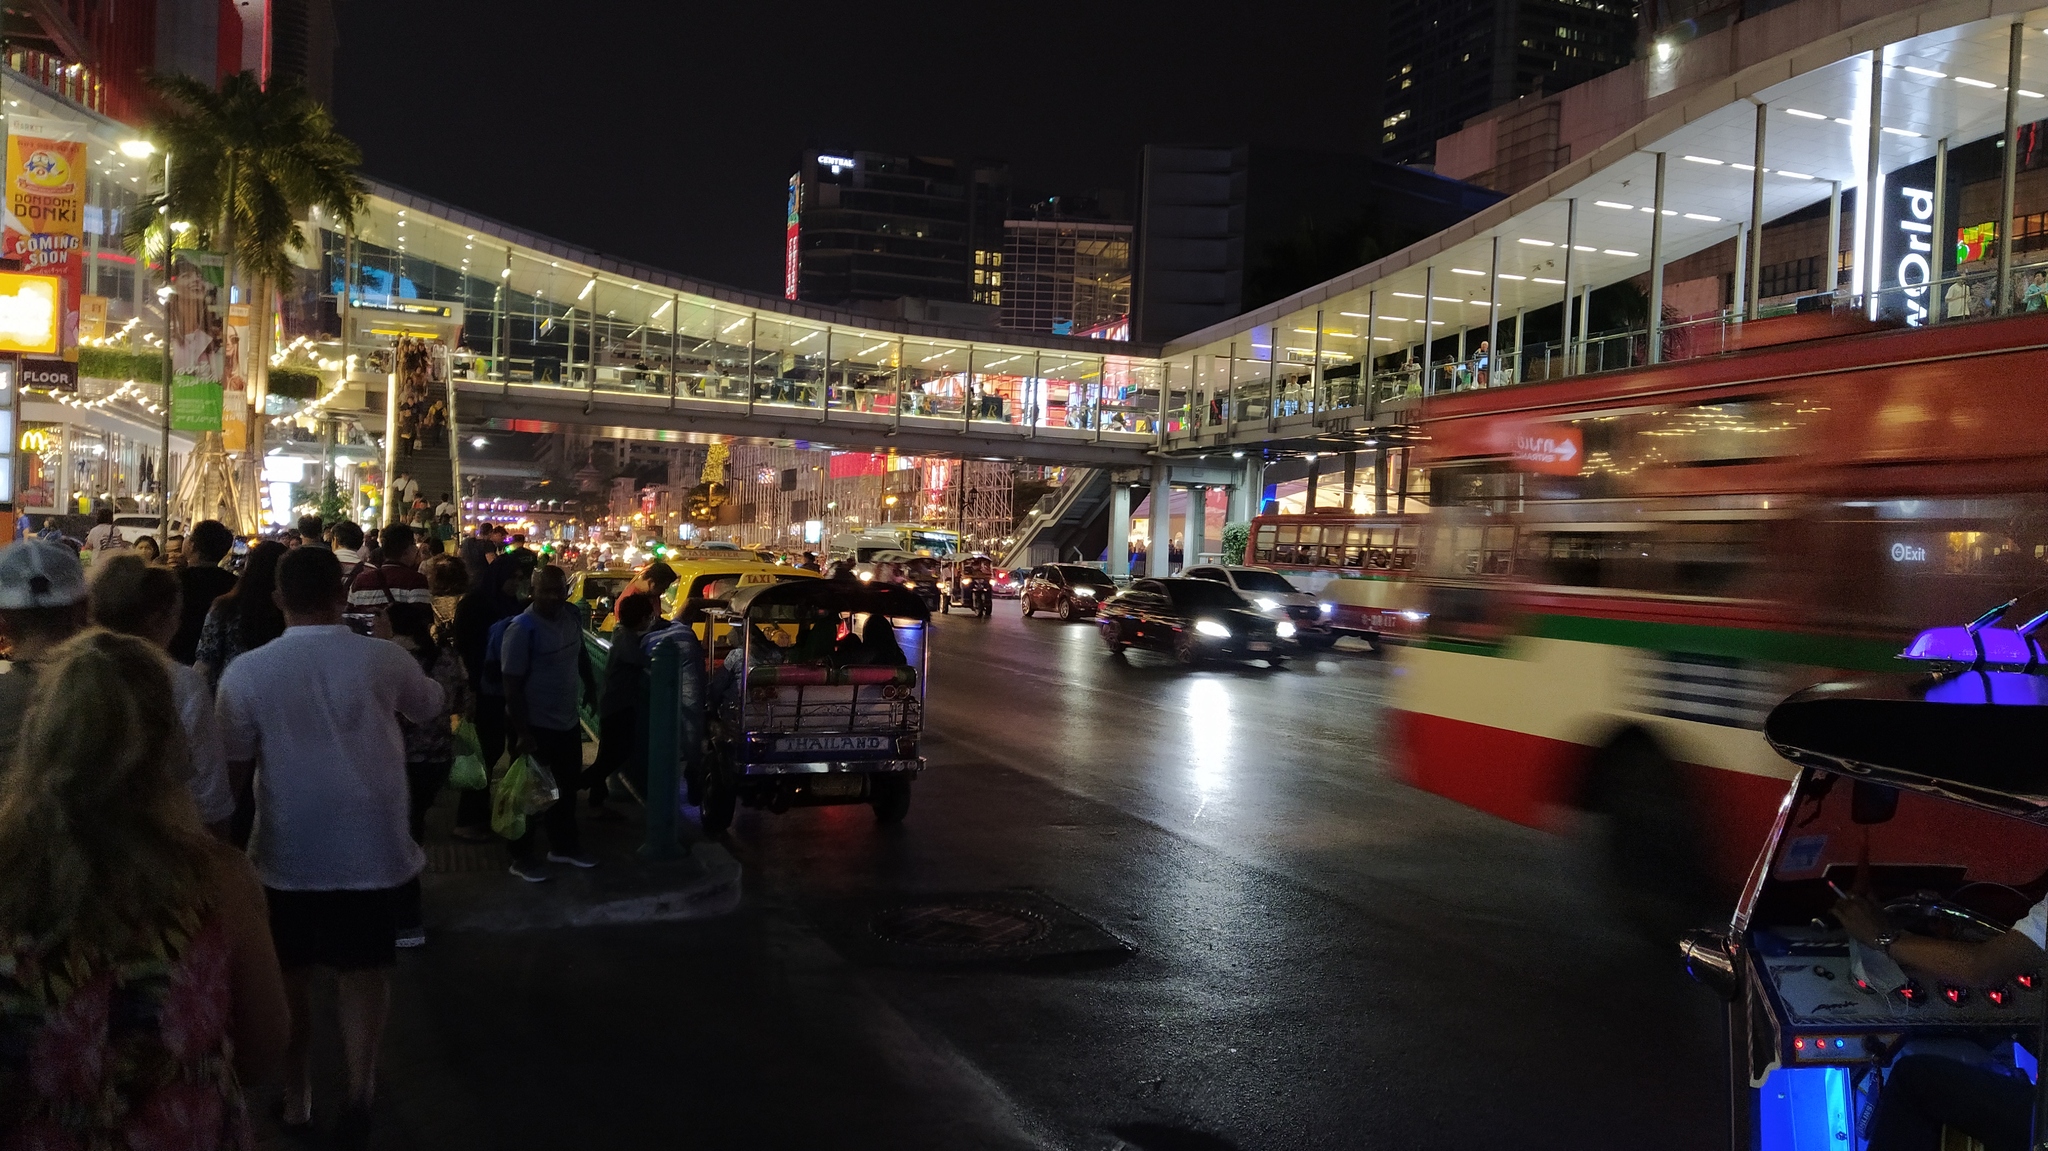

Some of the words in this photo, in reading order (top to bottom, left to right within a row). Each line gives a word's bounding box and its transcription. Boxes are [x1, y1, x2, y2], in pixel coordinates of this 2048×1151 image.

[817, 155, 855, 167] CENTRAL
[15, 236, 79, 254] COMING
[28, 250, 68, 267] SOON
[23, 371, 69, 384] FLOOR
[1905, 545, 1925, 561] Exit
[745, 574, 771, 584] TAXI
[787, 736, 881, 750] THAILAND
